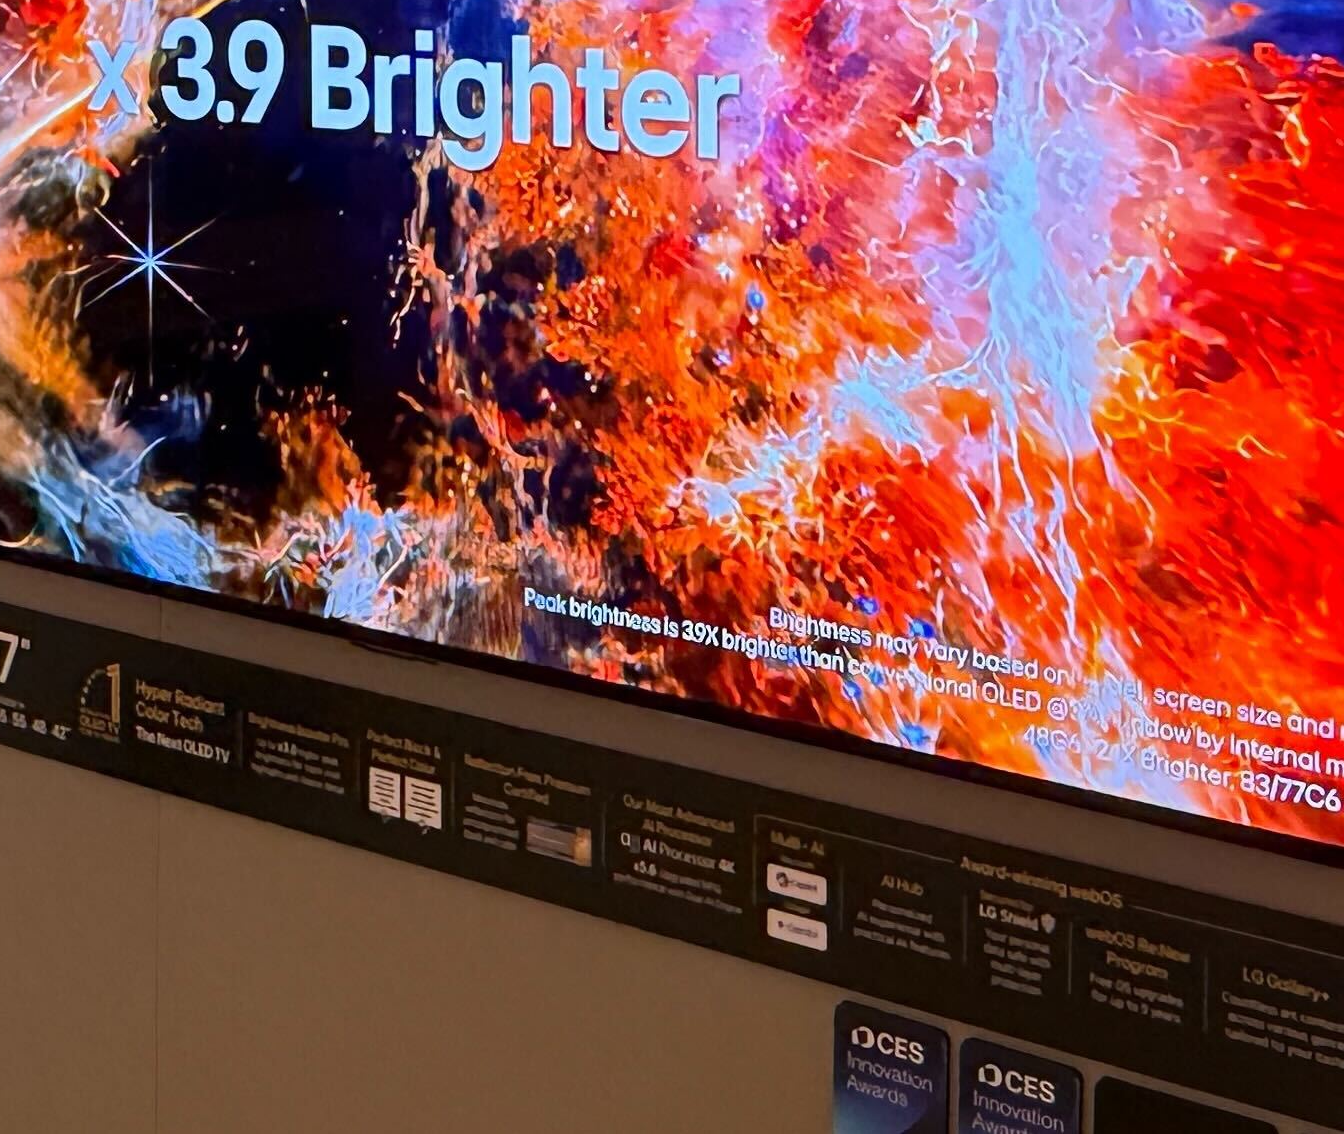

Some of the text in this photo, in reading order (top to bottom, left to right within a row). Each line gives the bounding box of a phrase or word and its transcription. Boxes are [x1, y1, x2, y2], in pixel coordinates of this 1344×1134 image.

[159, 18, 285, 124] 3.9
[310, 26, 740, 172] Brighter
[523, 587, 568, 615] Peak
[569, 599, 661, 636] brightness
[722, 629, 799, 662] brighter
[799, 643, 844, 673] than
[982, 681, 1042, 713] OLED
[1195, 725, 1226, 757] by
[769, 606, 872, 648] Brightness
[876, 632, 919, 661] may
[923, 640, 969, 669] vary
[972, 649, 1039, 680] based
[1153, 687, 1232, 718] screen
[1236, 702, 1282, 729] size
[1287, 716, 1335, 739] and
[136, 678, 173, 703] Hyper
[136, 700, 170, 723] Color
[171, 709, 204, 733] Tech
[136, 725, 156, 744] The
[184, 738, 214, 759] OLED
[215, 746, 231, 764] TV
[1239, 772, 1342, 813] 83/77C6
[979, 903, 997, 921] LG
[1242, 965, 1264, 986] LG
[876, 1032, 925, 1065] CES
[847, 1050, 933, 1093] Innovation
[1005, 1070, 1056, 1104] CES
[847, 1074, 908, 1108] Awards
[973, 1089, 1065, 1133] Innovation
